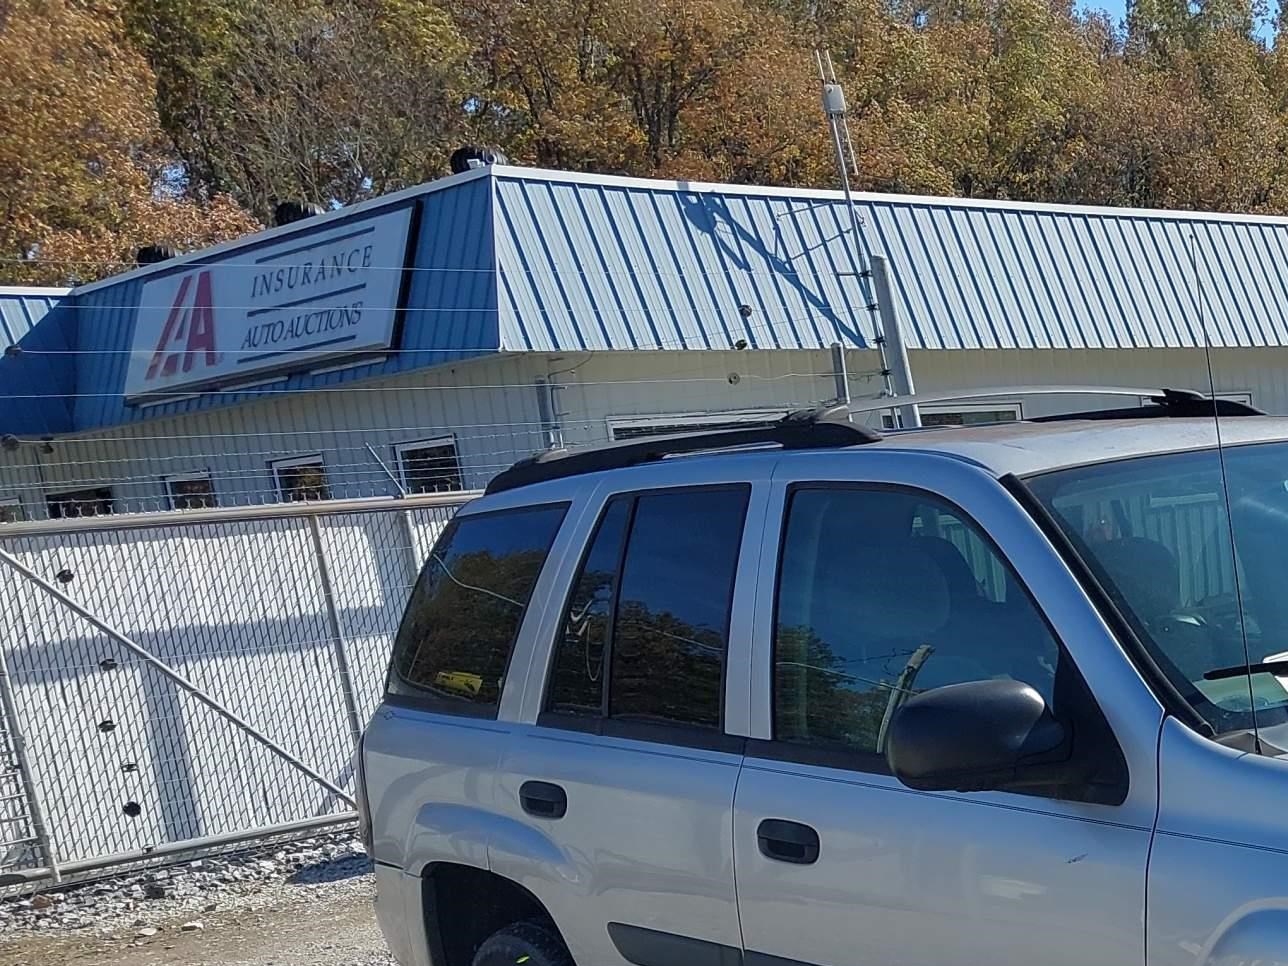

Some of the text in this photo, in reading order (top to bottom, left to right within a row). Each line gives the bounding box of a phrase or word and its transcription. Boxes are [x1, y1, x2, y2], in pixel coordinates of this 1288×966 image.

[250, 245, 373, 298] INSURANCE
[241, 301, 363, 350] AUTO AUCTIONS
